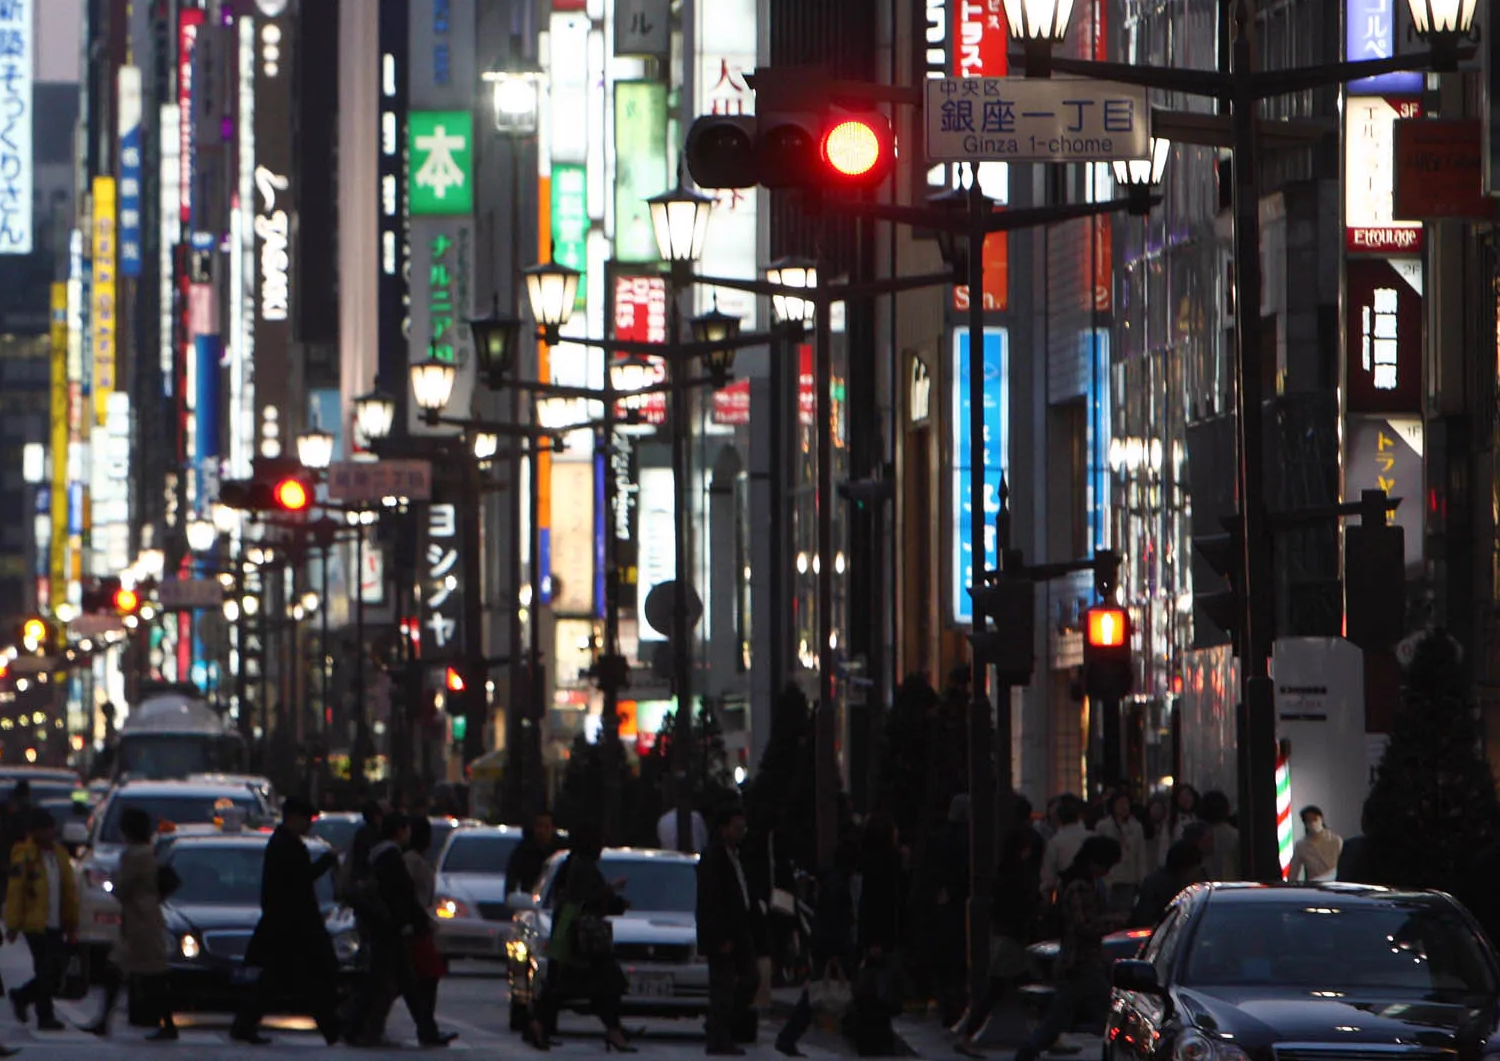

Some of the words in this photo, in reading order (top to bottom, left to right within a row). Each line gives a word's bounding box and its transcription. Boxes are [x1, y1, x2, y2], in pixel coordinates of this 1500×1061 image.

[939, 79, 1001, 98] 中央区
[940, 99, 1134, 133] 銀座一丁目
[1400, 104, 1419, 119] 3F
[963, 135, 1019, 154] Ginza
[1029, 135, 1114, 154] 1-chome
[415, 125, 466, 199] 本
[255, 210, 288, 320] TASAKI
[426, 504, 458, 647] ヨシノヤ
